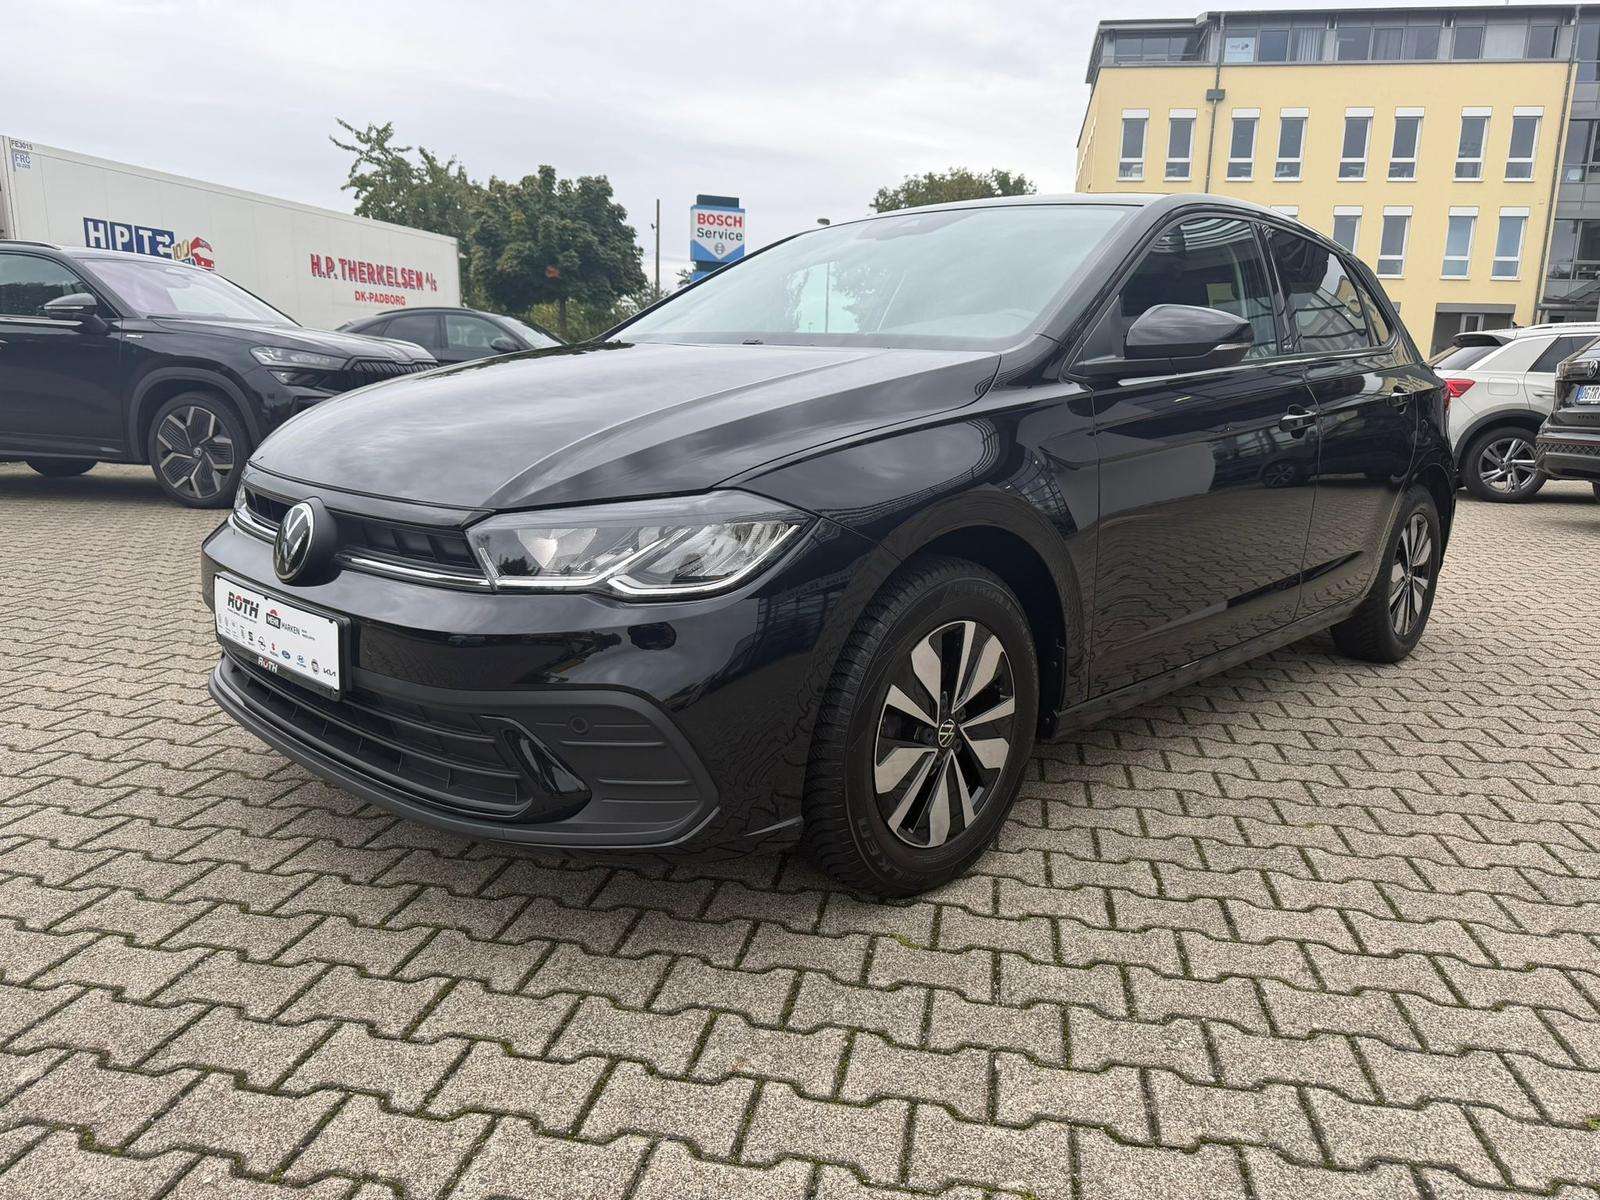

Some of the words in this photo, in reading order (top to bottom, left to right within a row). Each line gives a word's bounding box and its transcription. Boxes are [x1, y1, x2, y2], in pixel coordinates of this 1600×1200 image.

[697, 213, 743, 227] BOSCH
[697, 227, 743, 241] Service
[310, 254, 338, 280] H.P.
[338, 258, 424, 291] THERKELSEN
[227, 591, 260, 619] ROTH
[257, 657, 278, 674] ROTH
